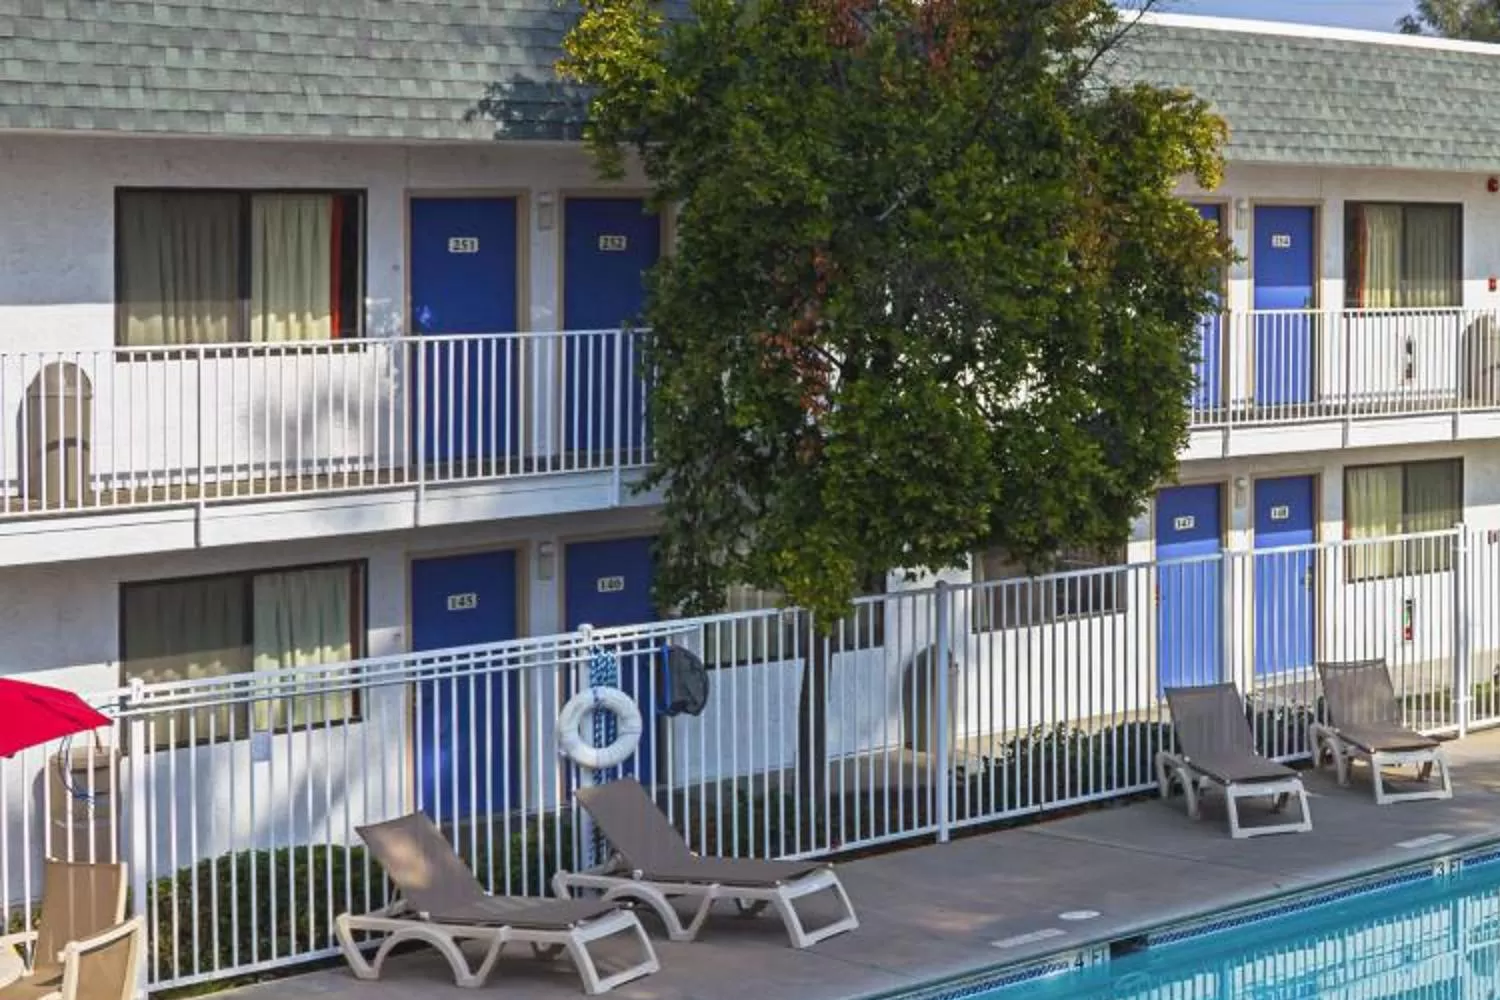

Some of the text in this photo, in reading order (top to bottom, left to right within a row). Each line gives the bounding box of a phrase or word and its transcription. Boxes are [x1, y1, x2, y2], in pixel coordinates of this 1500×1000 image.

[452, 239, 475, 250] 251
[450, 595, 473, 609] 145
[1074, 951, 1085, 967] 4
